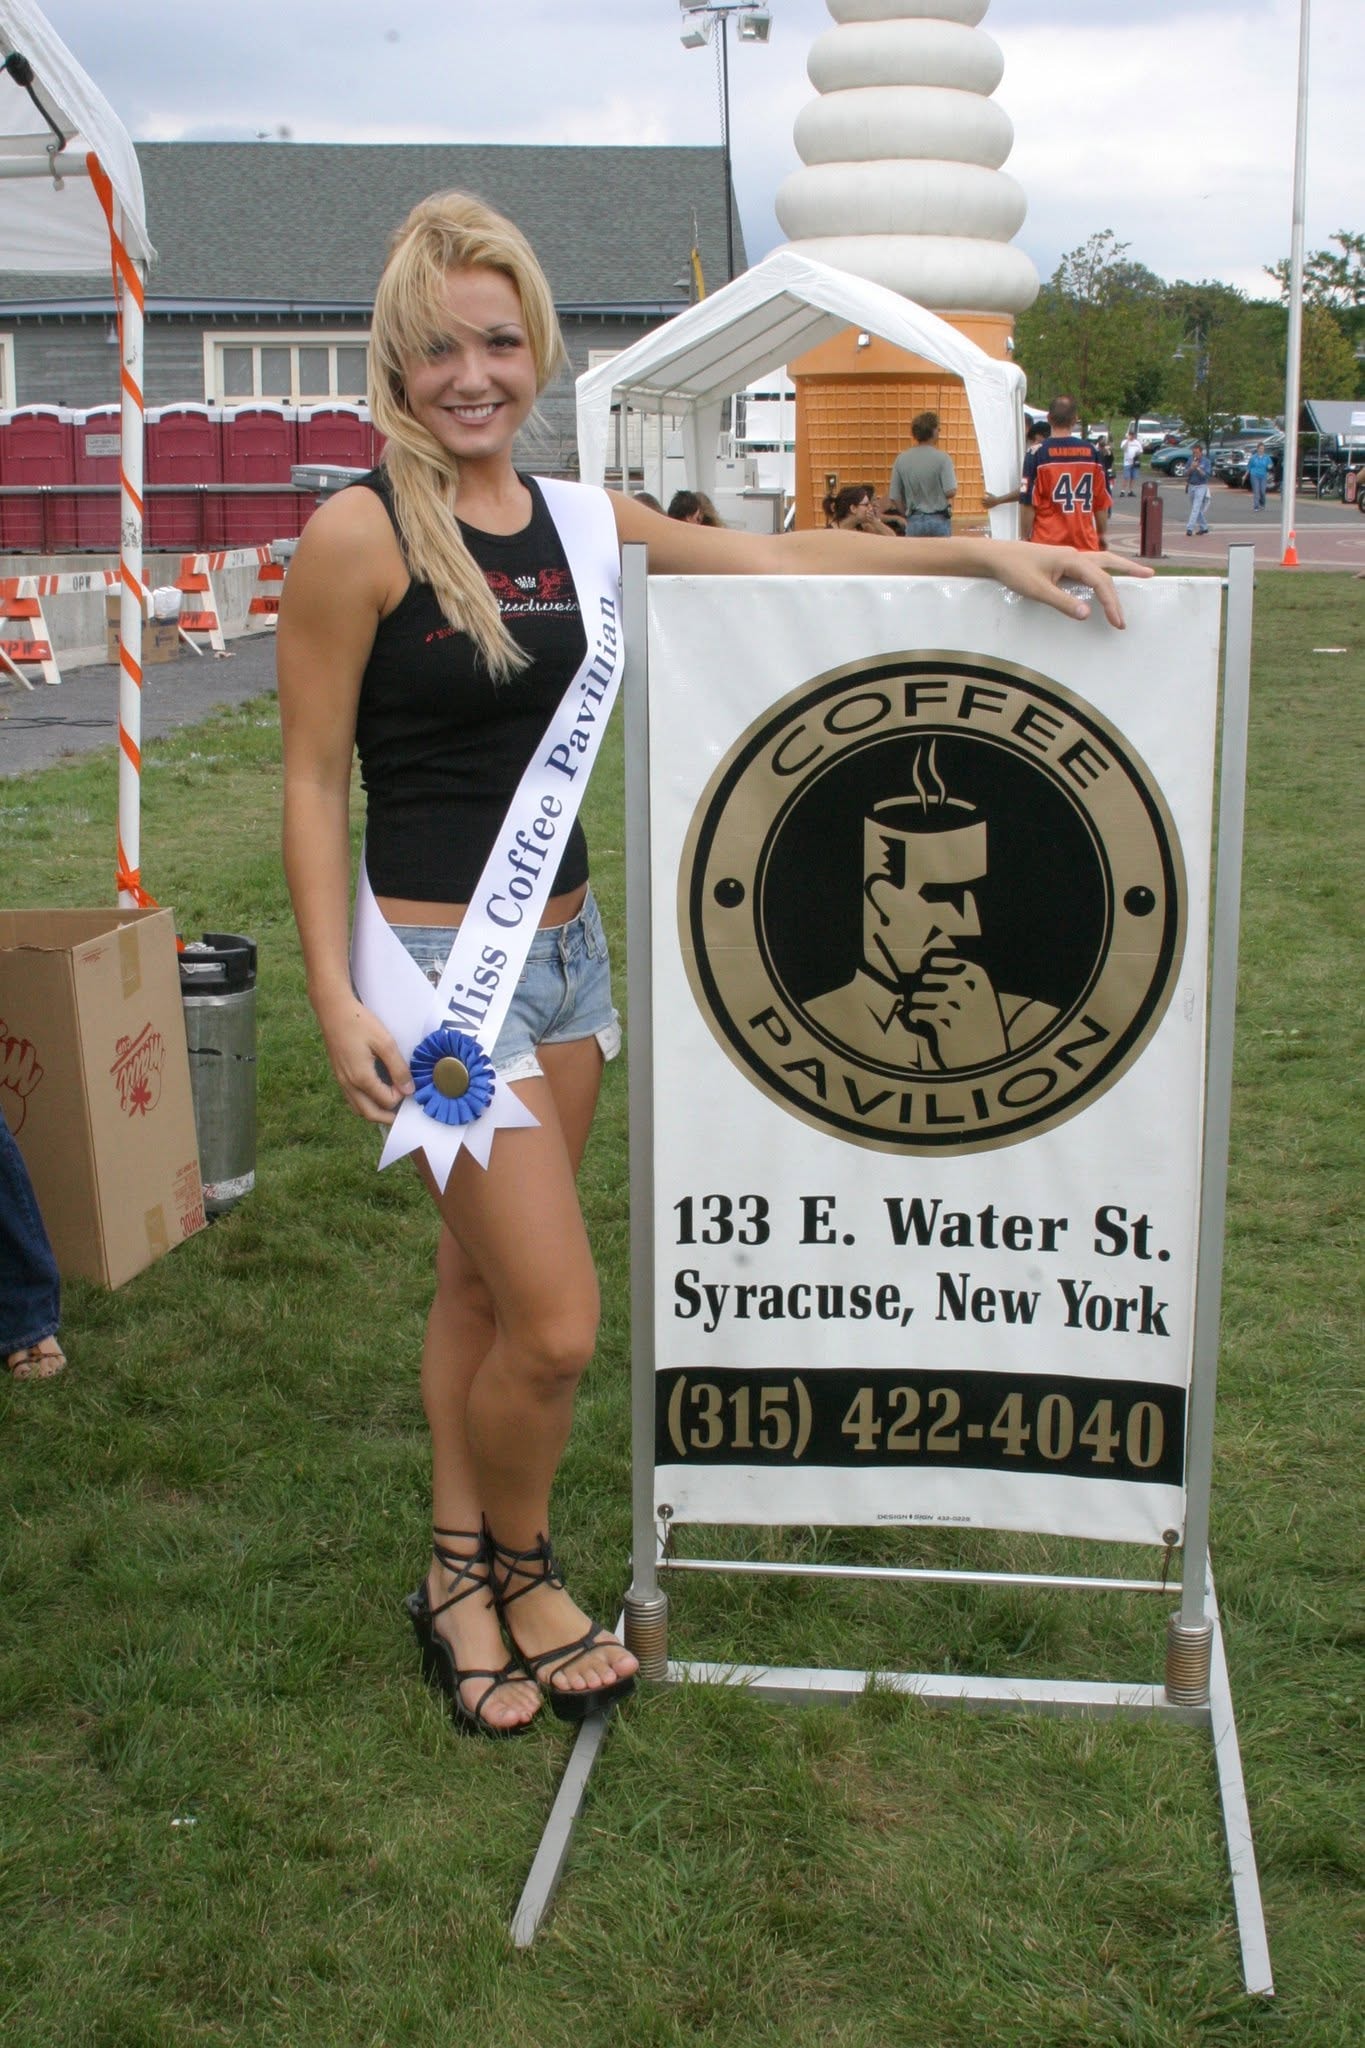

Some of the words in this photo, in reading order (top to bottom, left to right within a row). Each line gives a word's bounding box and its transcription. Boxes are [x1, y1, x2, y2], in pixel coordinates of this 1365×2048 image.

[1053, 472, 1094, 513] 44
[72, 575, 91, 591] OPW
[771, 681, 1110, 791] COFFEE
[440, 945, 508, 1038] Miss
[486, 794, 563, 928] Coffee
[544, 596, 616, 782] Pavillian
[748, 1005, 1111, 1124] PAVILION
[673, 1194, 771, 1245] 133
[799, 1195, 856, 1245] E.
[884, 1197, 1068, 1252] Water
[1093, 1205, 1171, 1262] St.
[674, 1269, 915, 1333] Syracuse,
[935, 1272, 1041, 1325] New
[1057, 1277, 1171, 1337] York
[667, 1374, 813, 1459] (315)
[841, 1386, 1165, 1468] 422-4040
[877, 1513, 908, 1521] DESIGN
